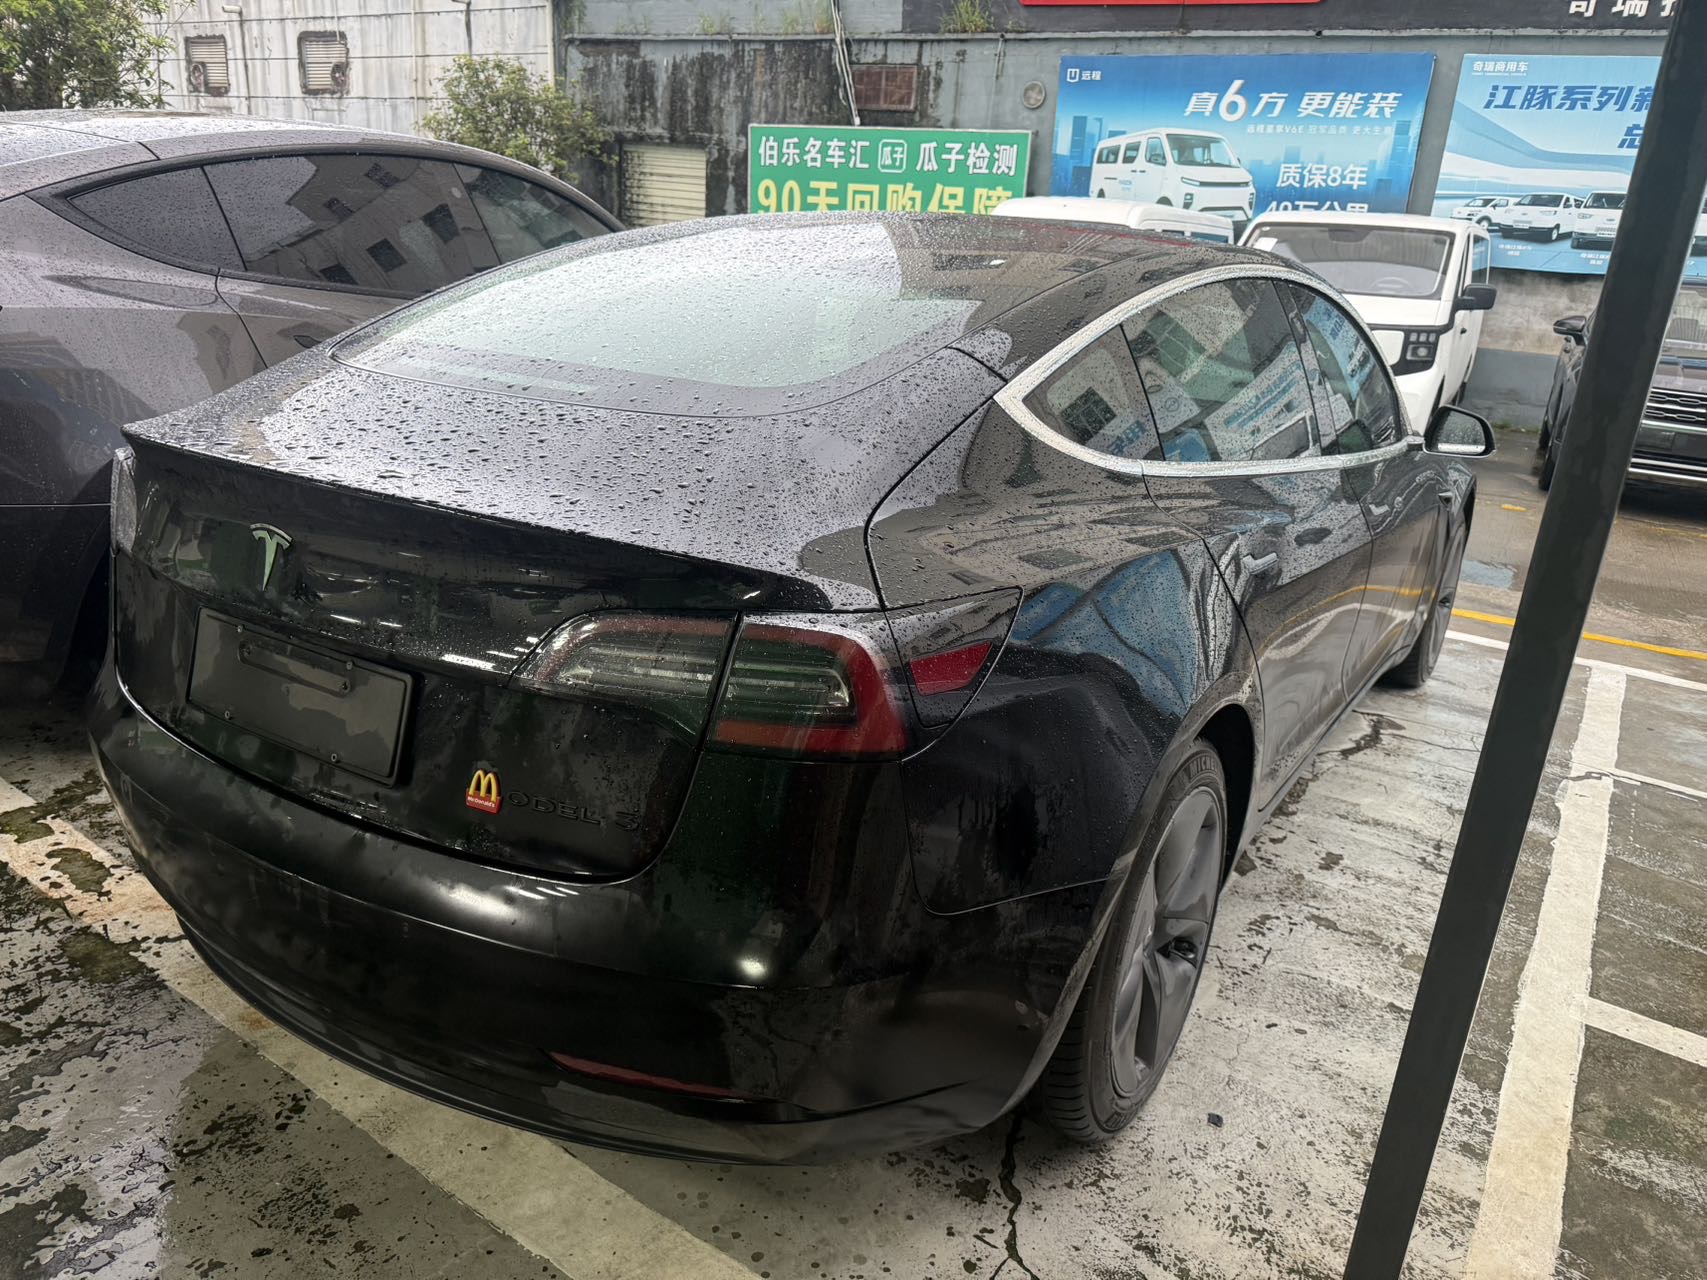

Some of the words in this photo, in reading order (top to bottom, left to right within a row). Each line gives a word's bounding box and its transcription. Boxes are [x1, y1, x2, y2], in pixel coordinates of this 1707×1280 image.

[1081, 71, 1102, 81] 远程
[1183, 79, 1289, 122] 真6方
[1297, 91, 1403, 119] 更能装
[758, 136, 870, 169] 伯乐名车汇
[915, 142, 1019, 176] 瓜子检测
[1276, 163, 1369, 190] 质保8年
